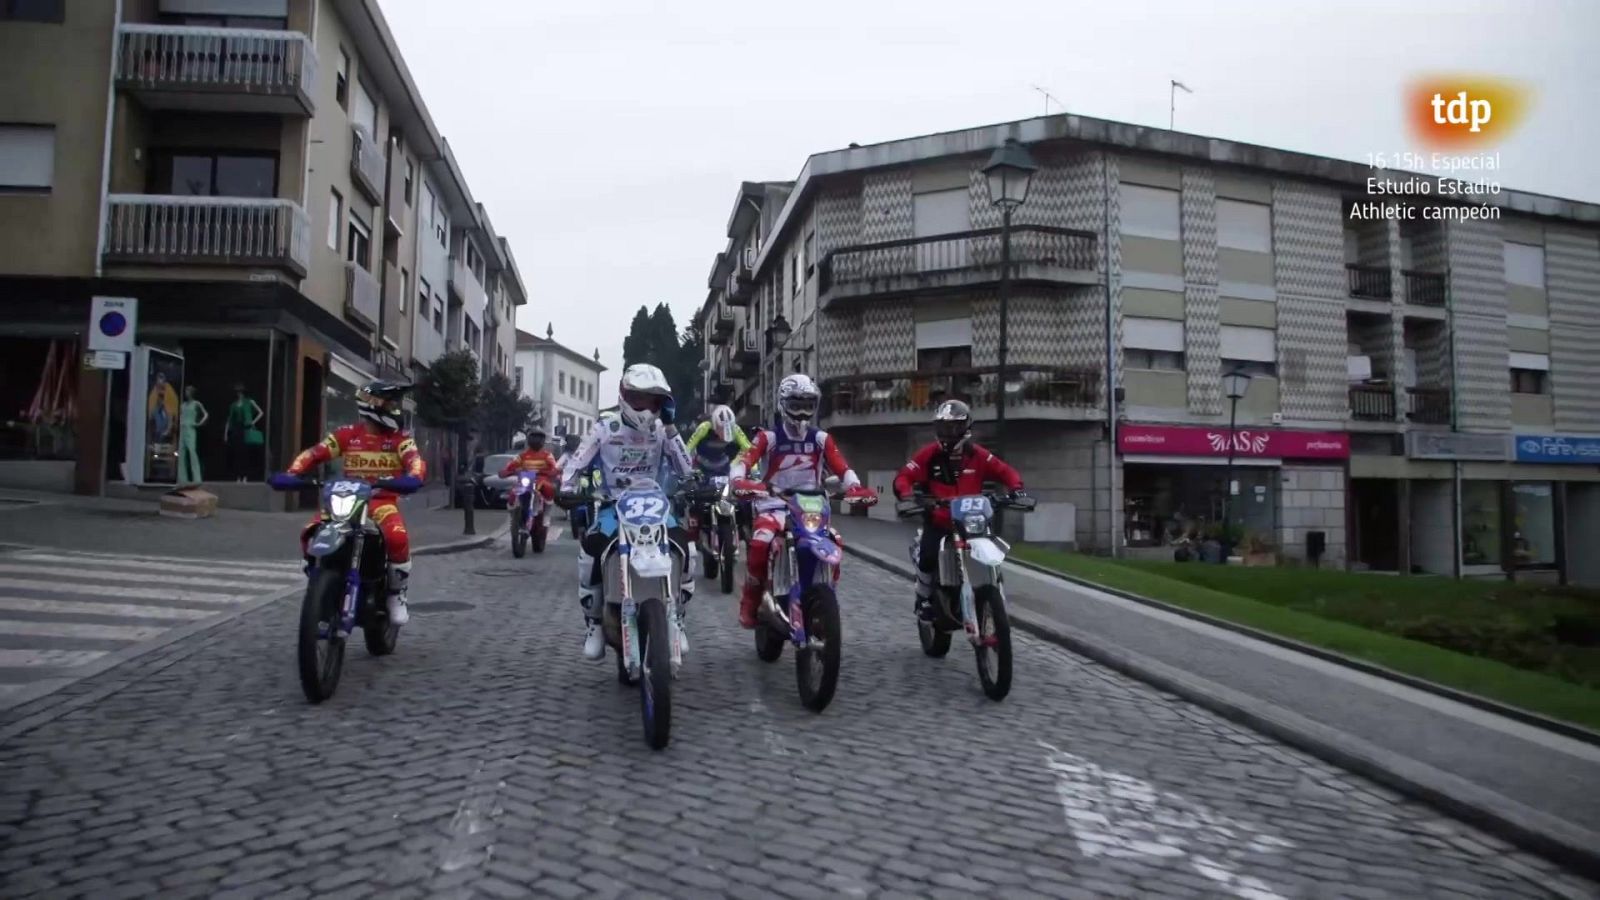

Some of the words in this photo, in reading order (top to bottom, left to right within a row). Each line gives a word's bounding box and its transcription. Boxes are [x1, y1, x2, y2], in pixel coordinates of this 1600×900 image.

[345, 454, 399, 469] ESPAÑA
[625, 496, 664, 519] 32
[960, 497, 984, 512] 83
